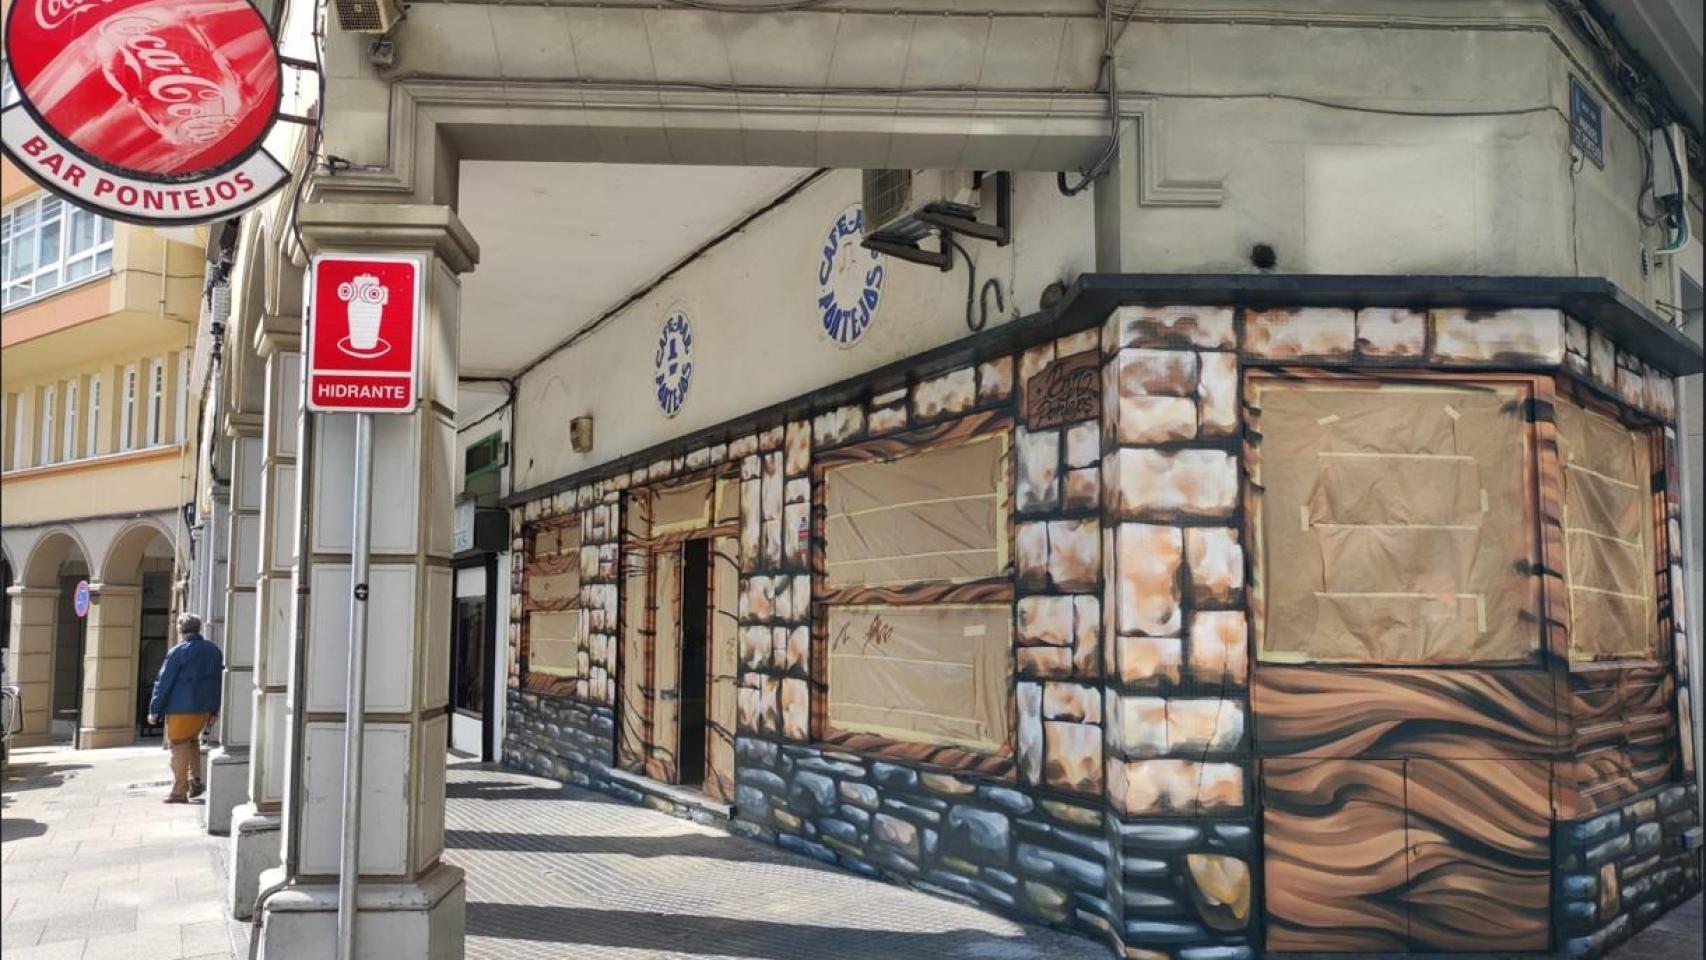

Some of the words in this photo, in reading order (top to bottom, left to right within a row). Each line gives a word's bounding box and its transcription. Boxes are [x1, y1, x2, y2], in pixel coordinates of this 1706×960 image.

[21, 135, 86, 188] BAR
[93, 171, 255, 211] PONTEJOS
[818, 265, 883, 343] PONTEJOS
[317, 383, 406, 399] HIDRANTE
